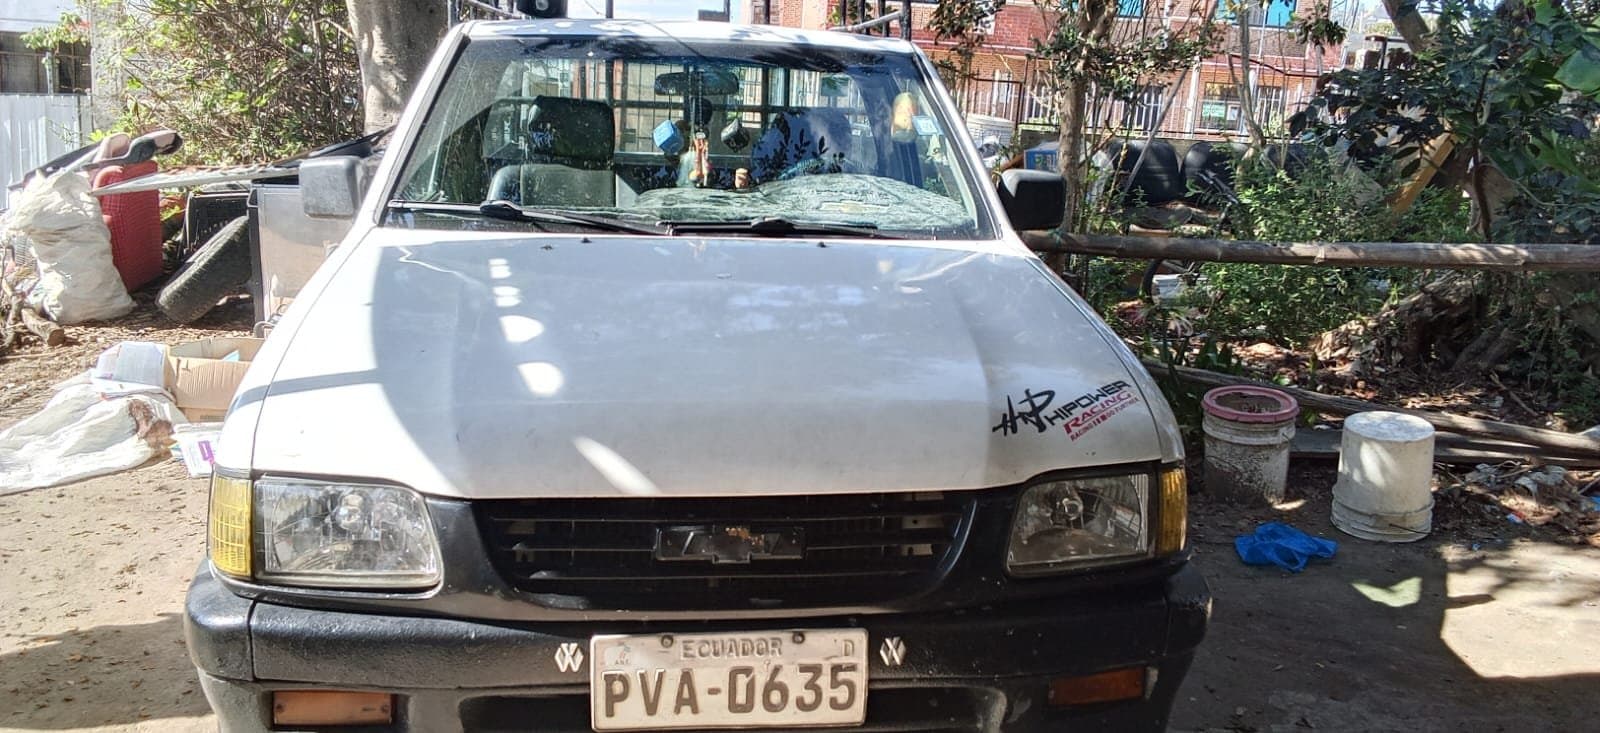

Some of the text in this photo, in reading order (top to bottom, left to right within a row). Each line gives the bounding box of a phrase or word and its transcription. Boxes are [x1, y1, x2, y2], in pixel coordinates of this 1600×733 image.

[1044, 380, 1132, 426] HIPOWER
[1063, 390, 1132, 435] RACING
[681, 637, 783, 658] ECUADOR
[602, 663, 858, 718] PVA-0635
